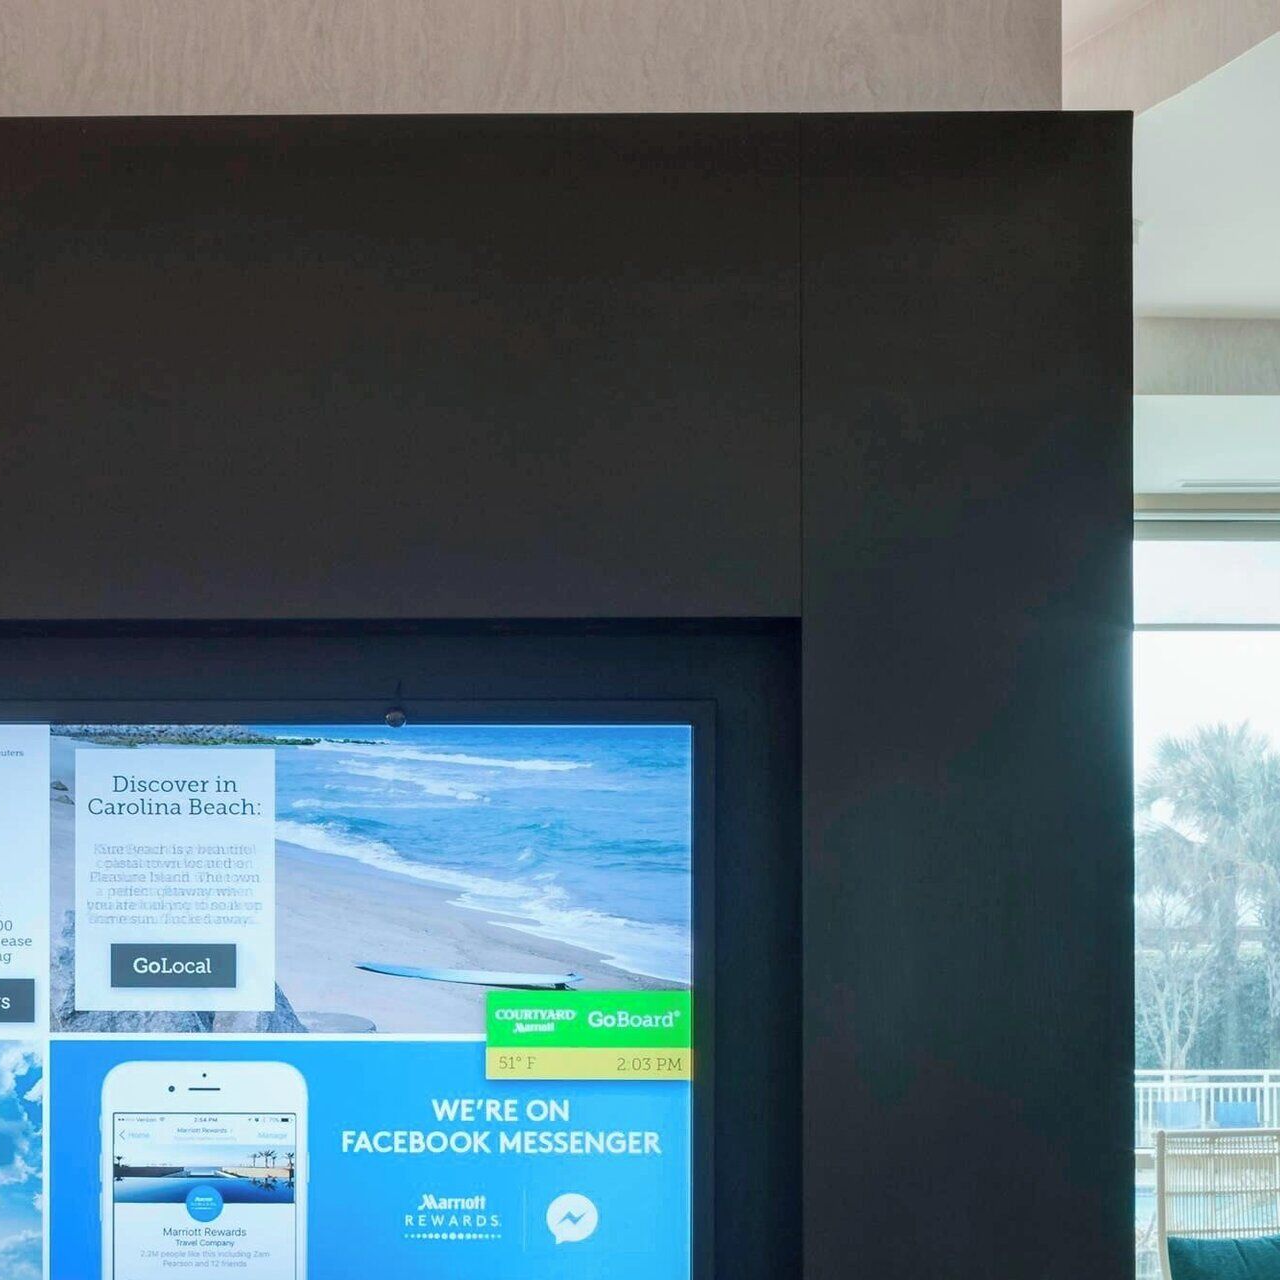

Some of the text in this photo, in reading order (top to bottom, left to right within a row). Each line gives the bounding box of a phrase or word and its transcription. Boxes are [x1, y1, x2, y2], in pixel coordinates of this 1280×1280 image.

[113, 775, 238, 792] Discover in
[88, 798, 261, 815] Carolina Beach:
[1, 937, 33, 947] ease
[133, 958, 211, 973] GoLocal
[495, 1009, 577, 1021] COURTYARD
[526, 1056, 537, 1070] F
[656, 1057, 683, 1071] PM
[432, 1099, 569, 1121] WE'RE ON
[342, 1131, 662, 1154] FACEBOOK MESSENGER
[417, 1194, 486, 1210] Marriott
[163, 1227, 247, 1237] Marriott Rewards
[175, 1239, 236, 1249] Travel Company
